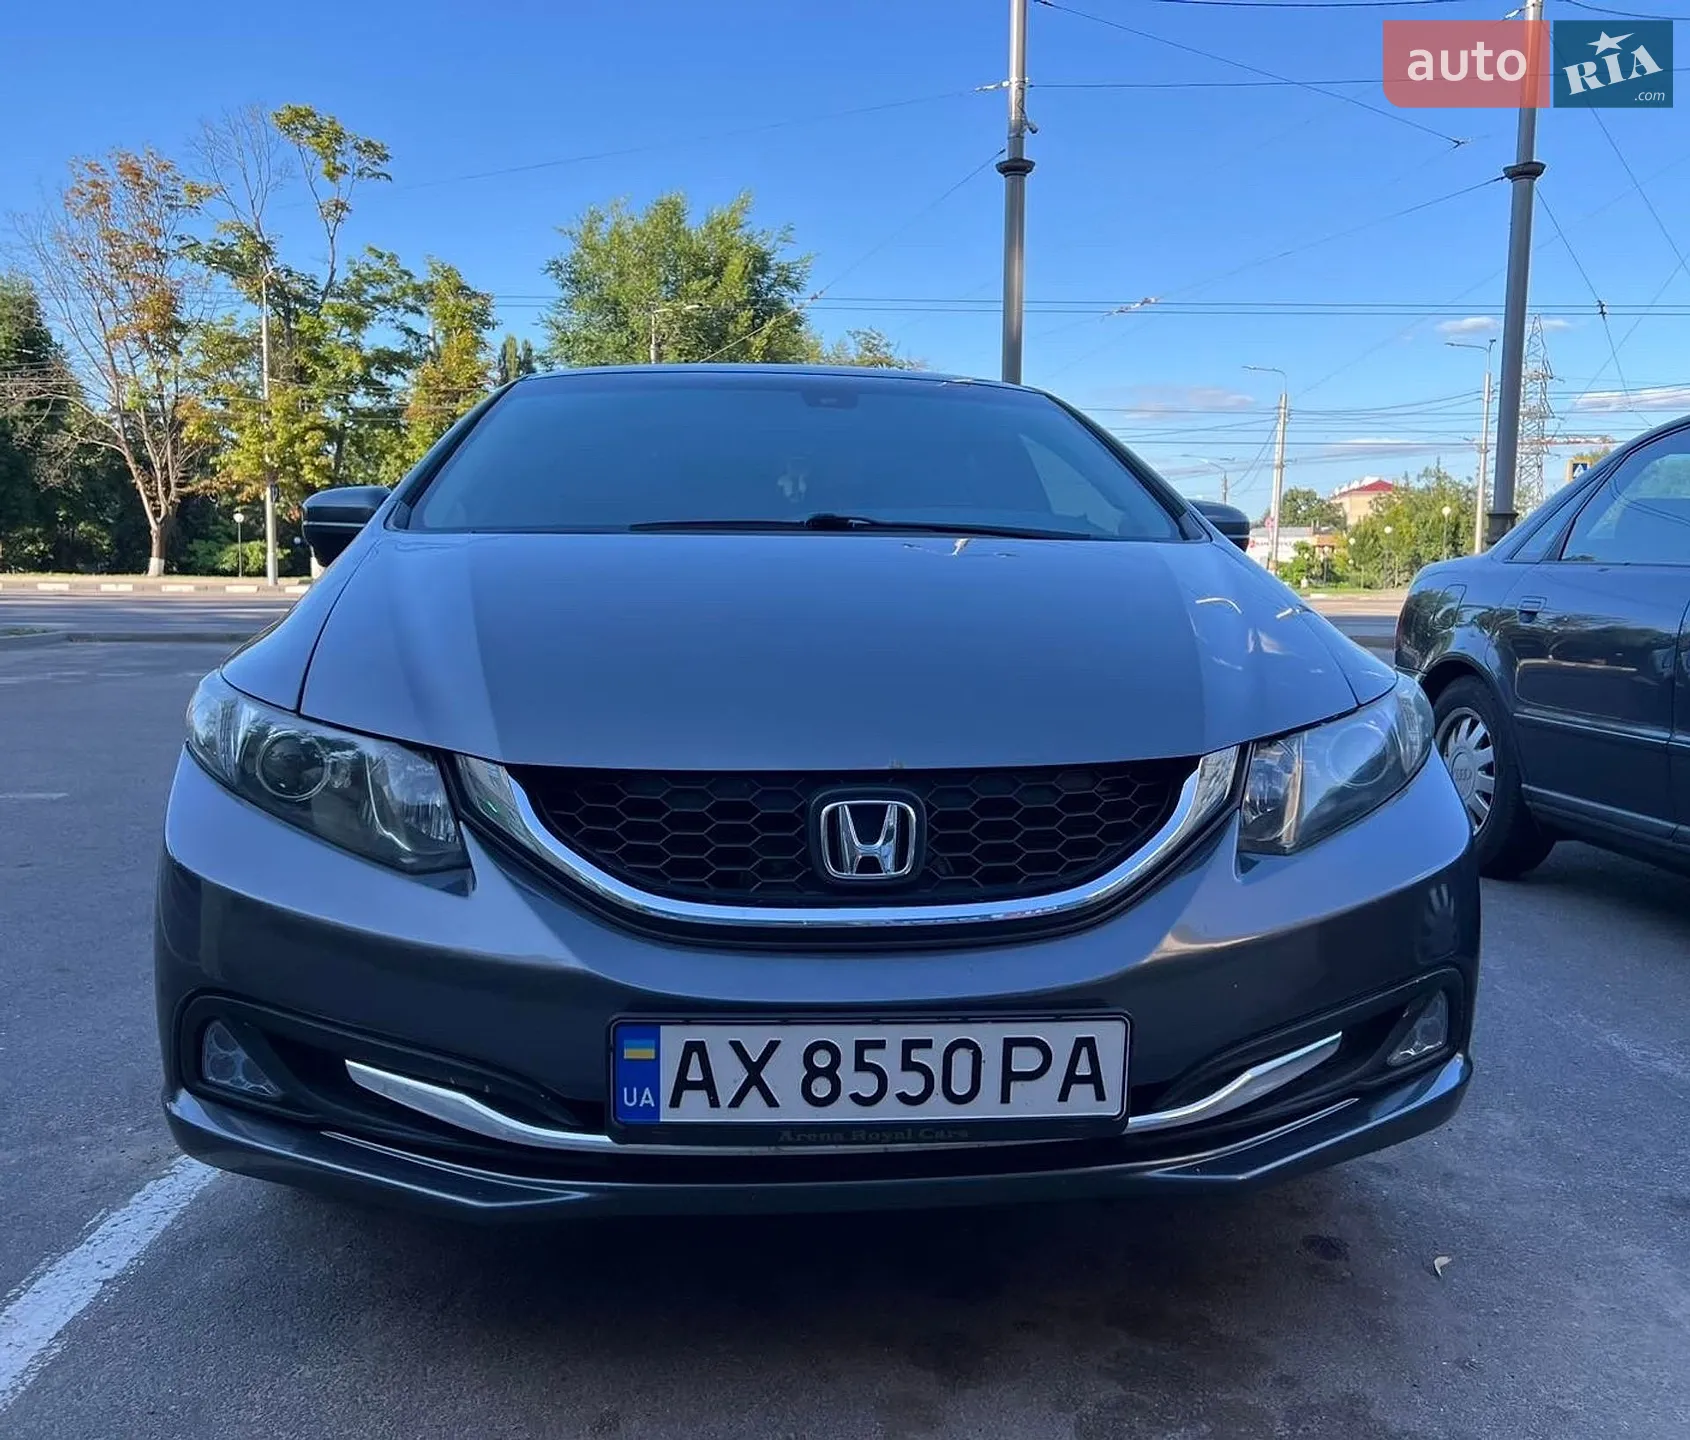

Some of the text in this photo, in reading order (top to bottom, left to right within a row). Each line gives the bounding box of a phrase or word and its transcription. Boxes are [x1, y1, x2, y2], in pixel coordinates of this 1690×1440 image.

[668, 1036, 1107, 1109] AX 8550 PA
[623, 1086, 656, 1109] UA
[852, 1127, 913, 1144] Royal
